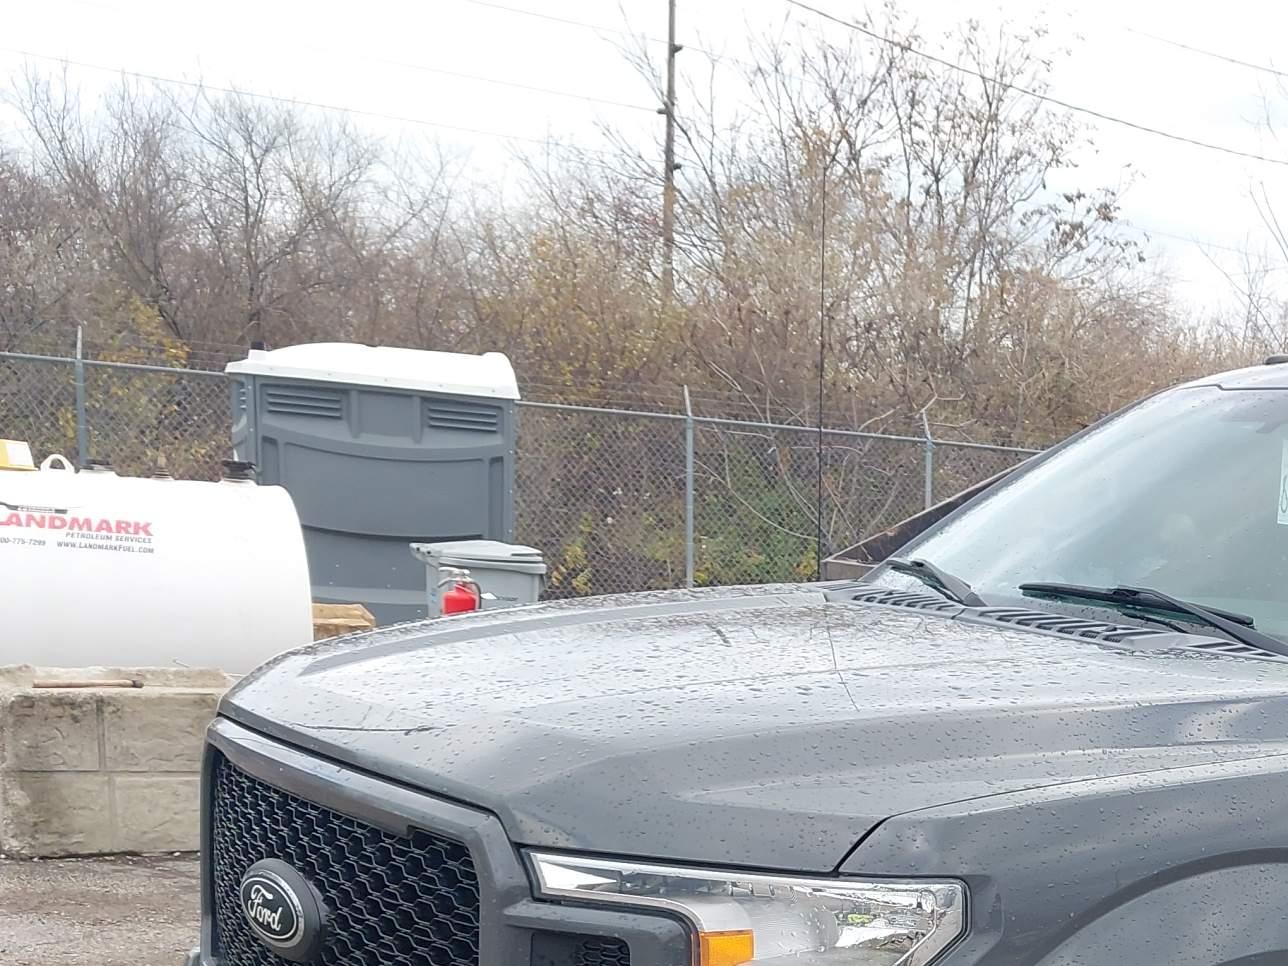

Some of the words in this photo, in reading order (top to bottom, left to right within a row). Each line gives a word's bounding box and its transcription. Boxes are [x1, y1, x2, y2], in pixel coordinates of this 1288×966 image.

[66, 531, 113, 542] PETROLEUM
[115, 535, 153, 544] SERVICES
[248, 884, 283, 931] Ford
